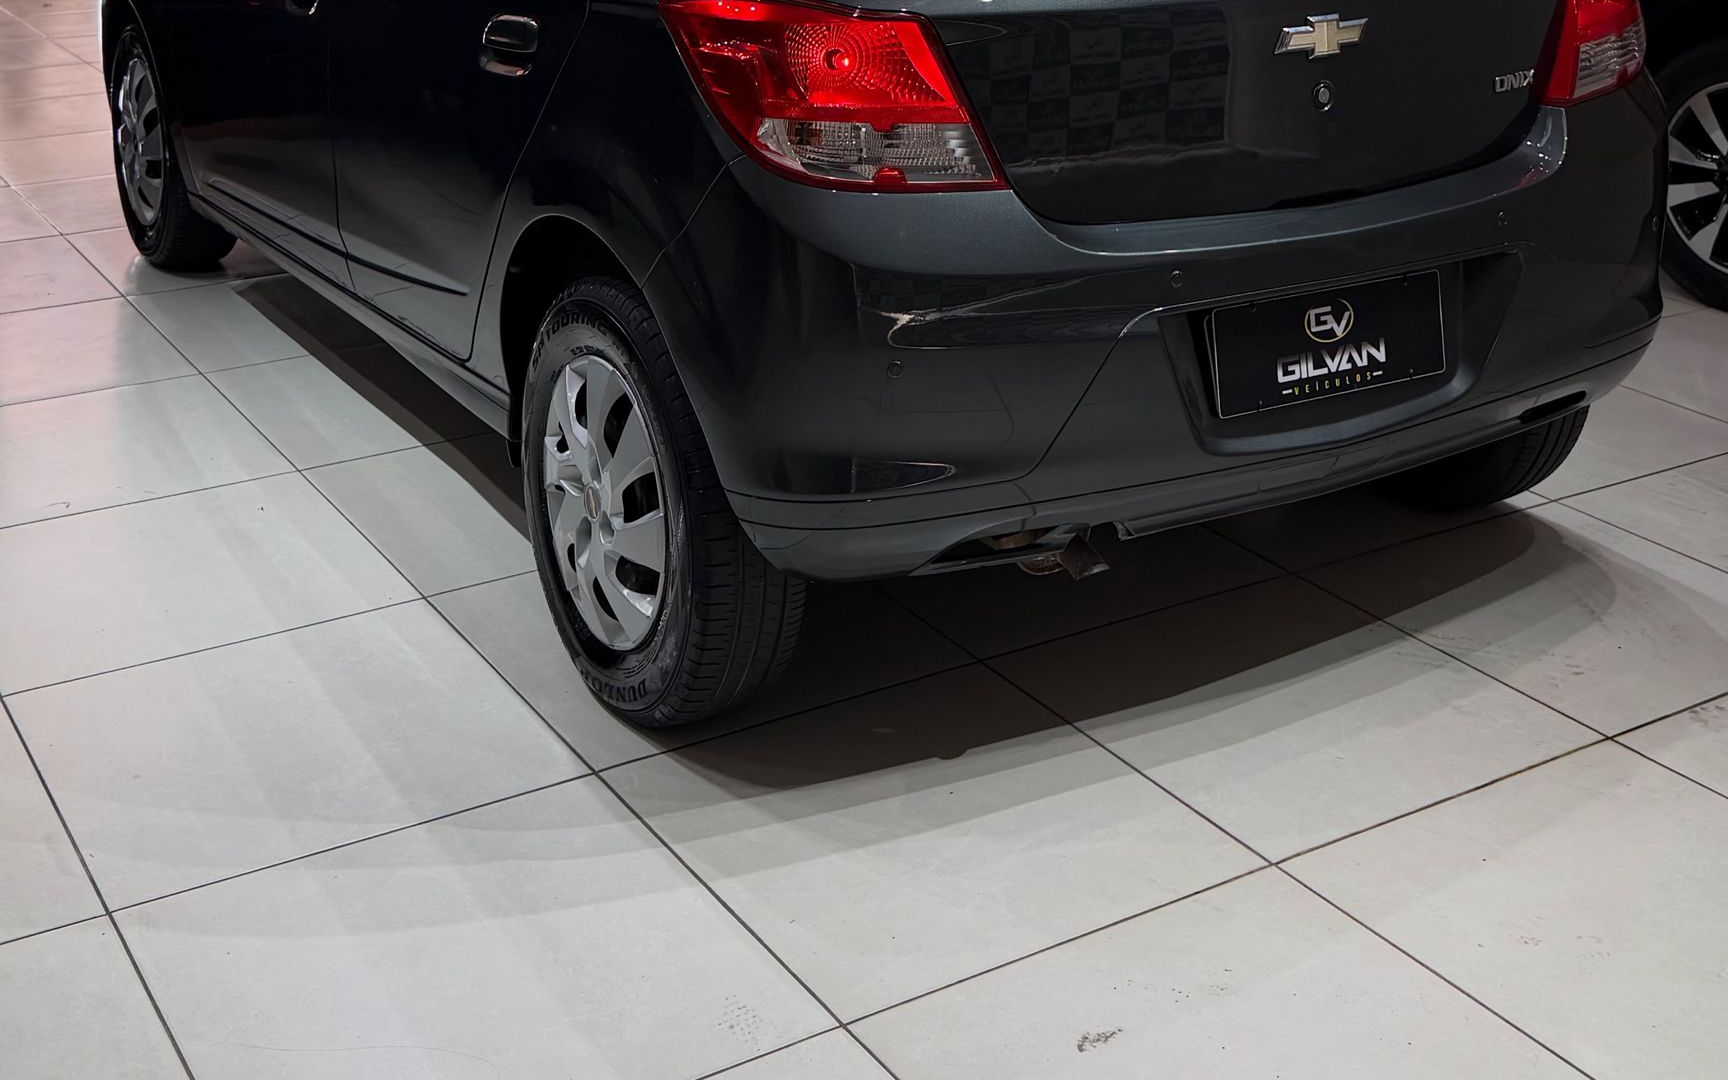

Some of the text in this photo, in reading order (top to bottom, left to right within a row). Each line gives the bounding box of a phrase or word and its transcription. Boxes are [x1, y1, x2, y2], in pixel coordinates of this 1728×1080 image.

[1495, 69, 1536, 93] ONIX
[543, 309, 610, 341] TOURING
[1310, 305, 1351, 337] GV
[1277, 337, 1387, 383] GILVAN
